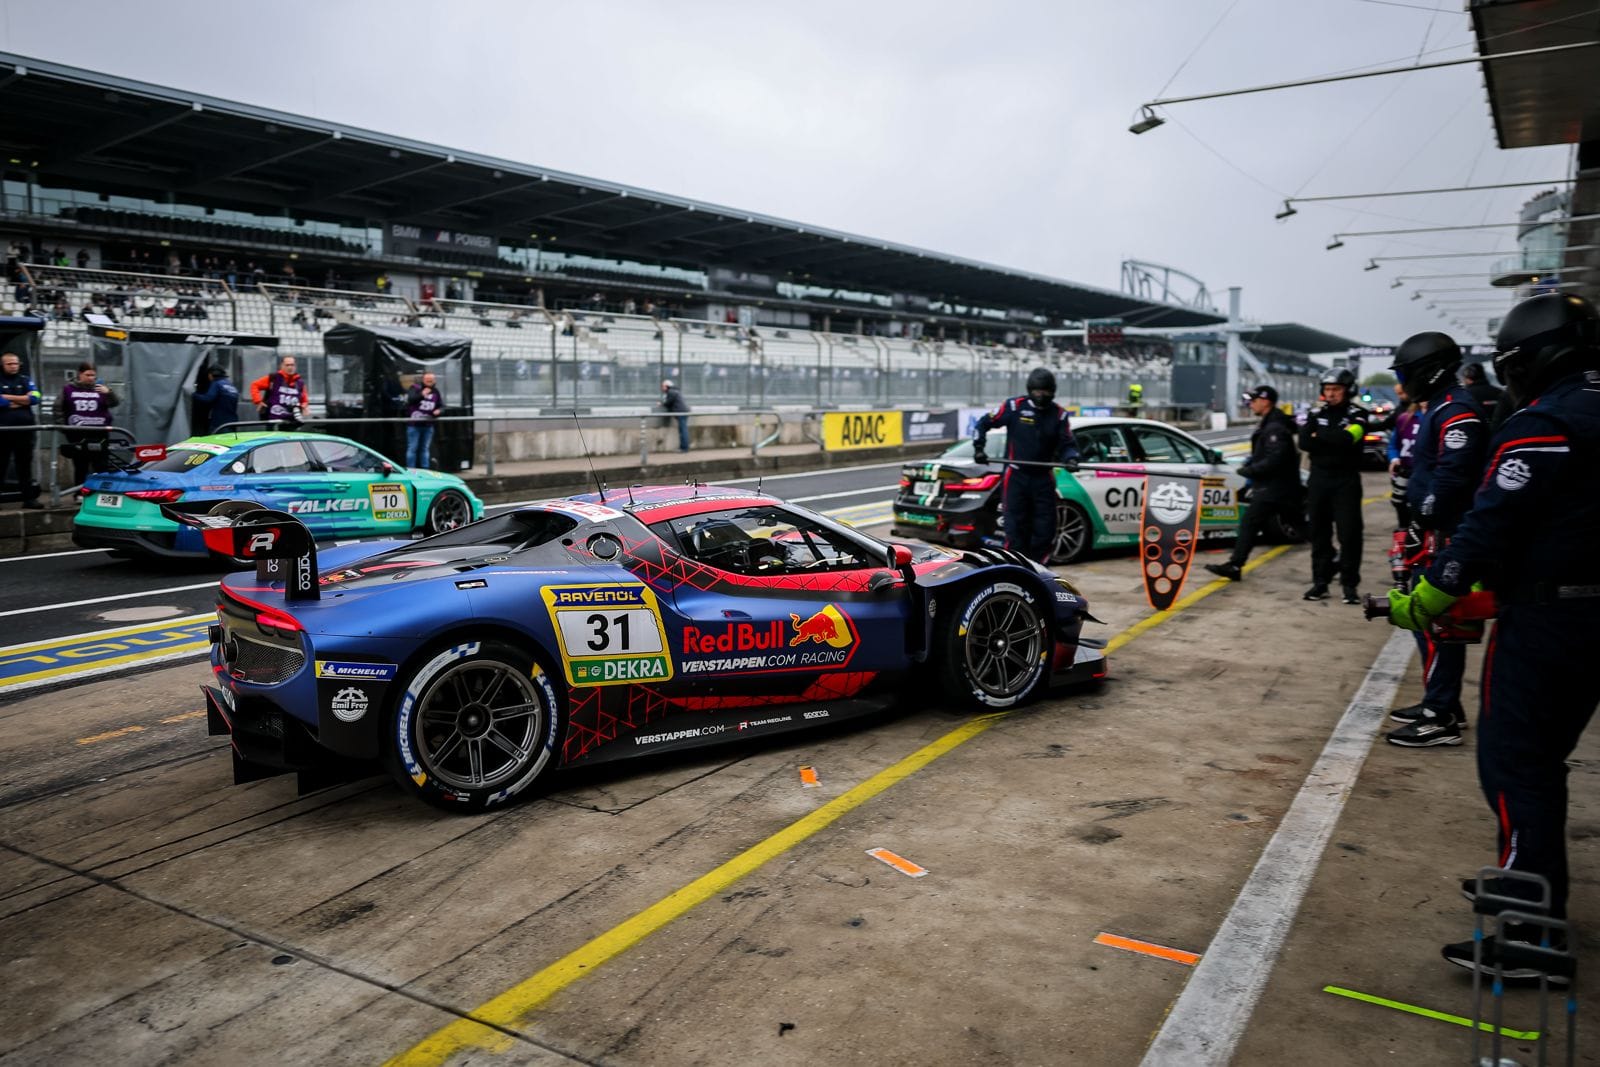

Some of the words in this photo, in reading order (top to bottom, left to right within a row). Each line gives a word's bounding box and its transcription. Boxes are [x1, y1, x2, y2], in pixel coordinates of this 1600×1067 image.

[392, 224, 421, 239] BMW
[455, 233, 492, 248] POWER
[841, 414, 886, 446] ADAC
[287, 497, 370, 514] FALKEN
[382, 494, 398, 509] 10
[1203, 489, 1230, 505] 504
[386, 511, 408, 519] DEKRA
[964, 586, 993, 620] MICHELIN
[586, 613, 630, 651] 31
[683, 624, 733, 654] Red
[737, 620, 785, 649] Bull
[337, 667, 388, 676] MICHELIN
[604, 659, 664, 680] DEKRA
[681, 653, 797, 673] VERSTAPPEN.COM
[800, 650, 846, 664] RACING
[350, 702, 369, 710] Frey
[543, 684, 558, 747] MICHELIN
[399, 694, 414, 765] MICHELIN
[634, 724, 725, 745] VERSTAPPEN.COM
[750, 719, 767, 727] TEAM
[767, 716, 792, 725] REDLINE
